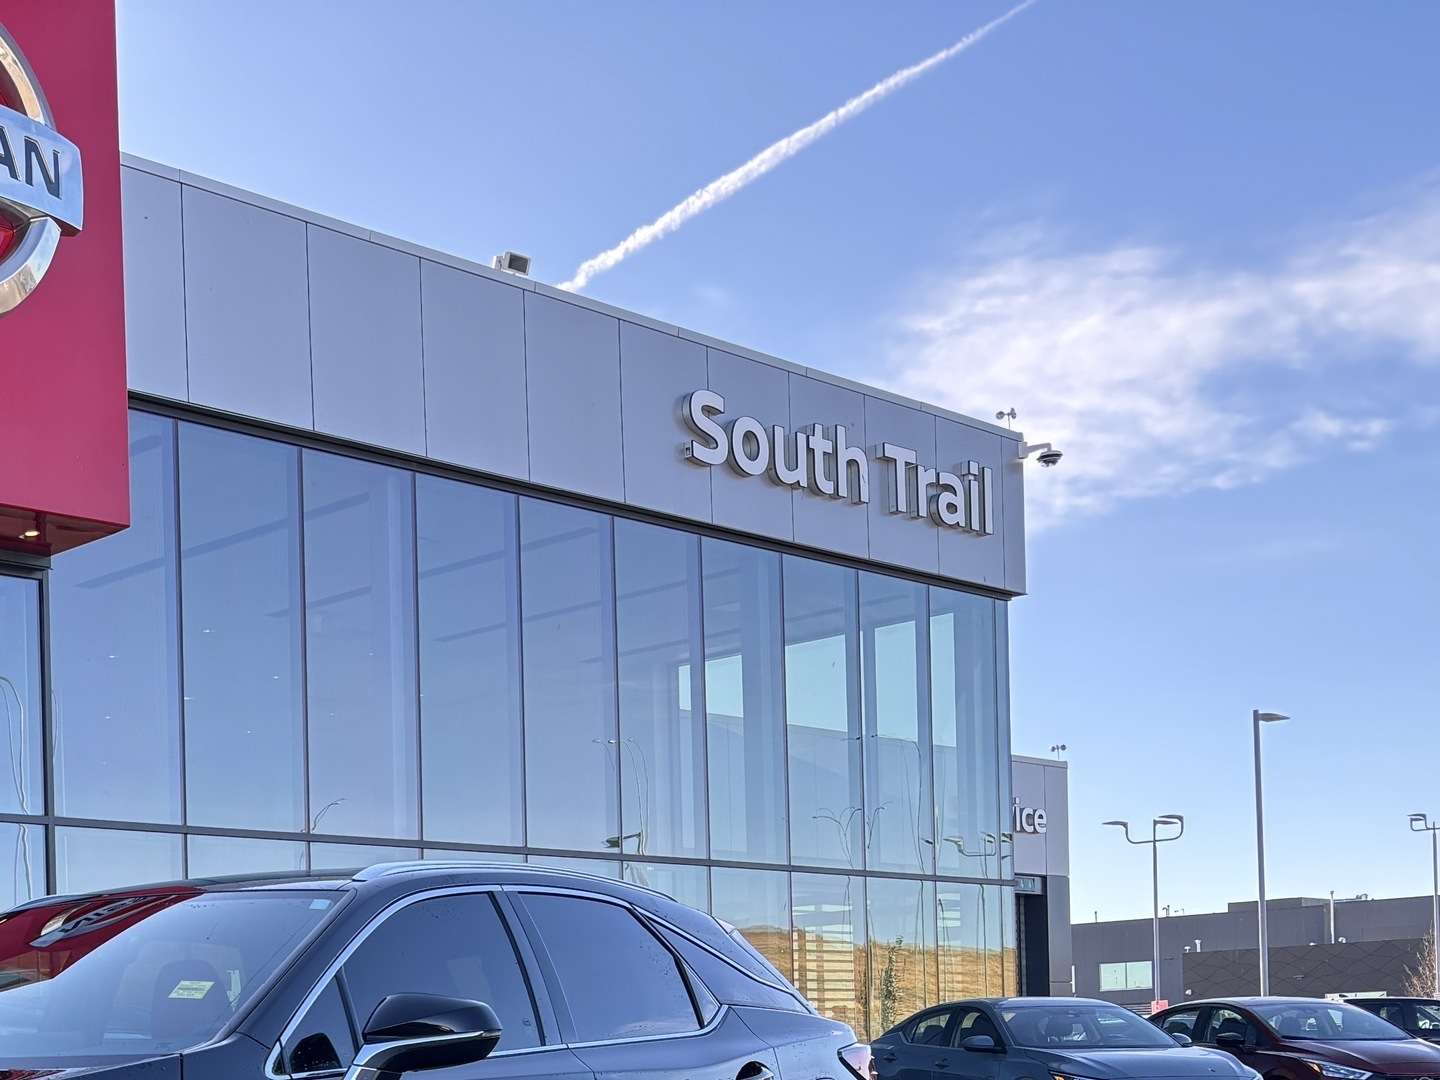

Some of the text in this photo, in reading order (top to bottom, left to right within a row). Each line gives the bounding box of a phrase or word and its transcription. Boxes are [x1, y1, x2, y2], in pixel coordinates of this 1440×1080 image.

[683, 389, 994, 536] South Trail
[1012, 797, 1047, 834] ice
